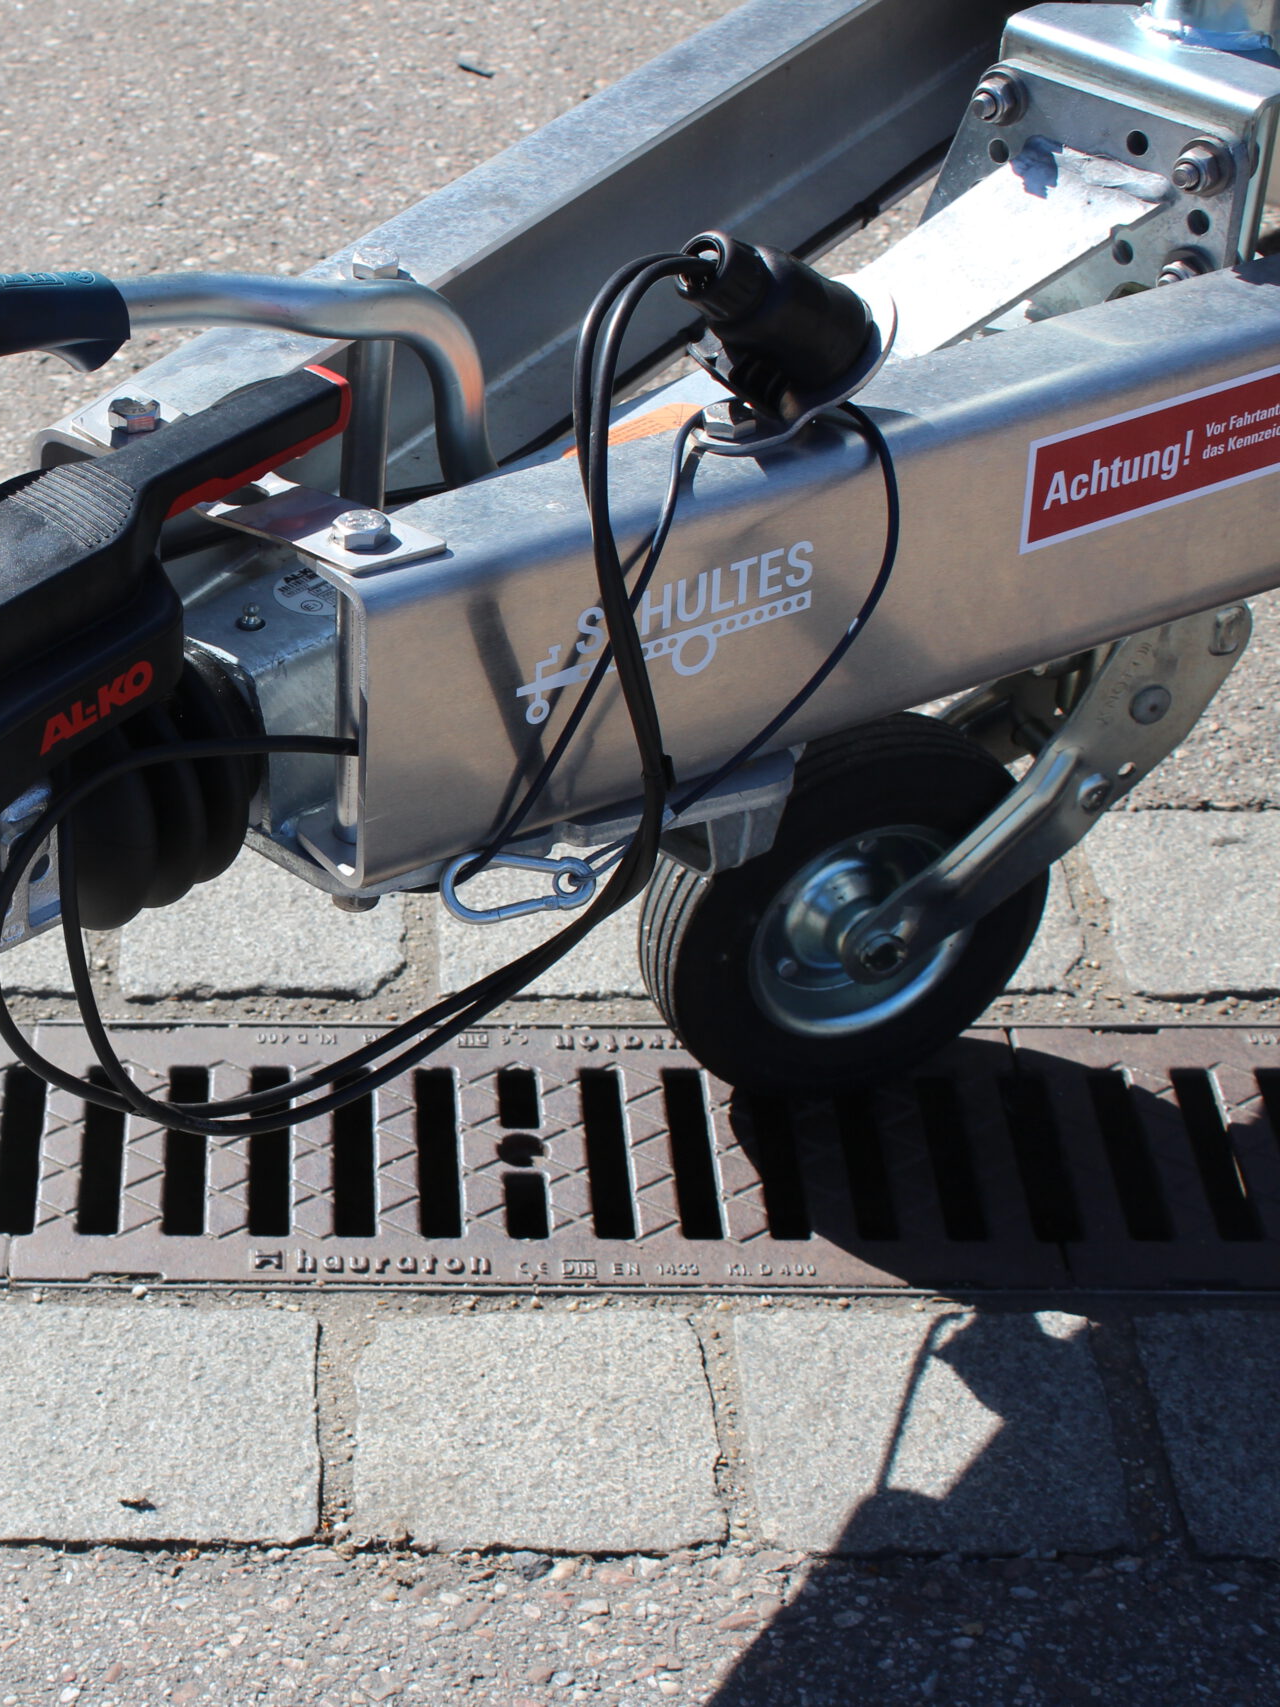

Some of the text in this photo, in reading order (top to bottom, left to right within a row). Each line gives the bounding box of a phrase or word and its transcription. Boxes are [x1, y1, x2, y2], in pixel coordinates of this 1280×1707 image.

[1206, 404, 1280, 437] Vor Fahrtant
[1043, 430, 1194, 511] Achtung!
[1202, 444, 1225, 459] das
[576, 541, 814, 655] SHULTES
[40, 661, 154, 756] AL-KO
[296, 1249, 492, 1275] hauraton
[561, 1260, 598, 1279] DIN
[612, 1263, 641, 1276] EN
[655, 1263, 700, 1276] 1433
[759, 1264, 773, 1276] D
[778, 1264, 817, 1276] 400
